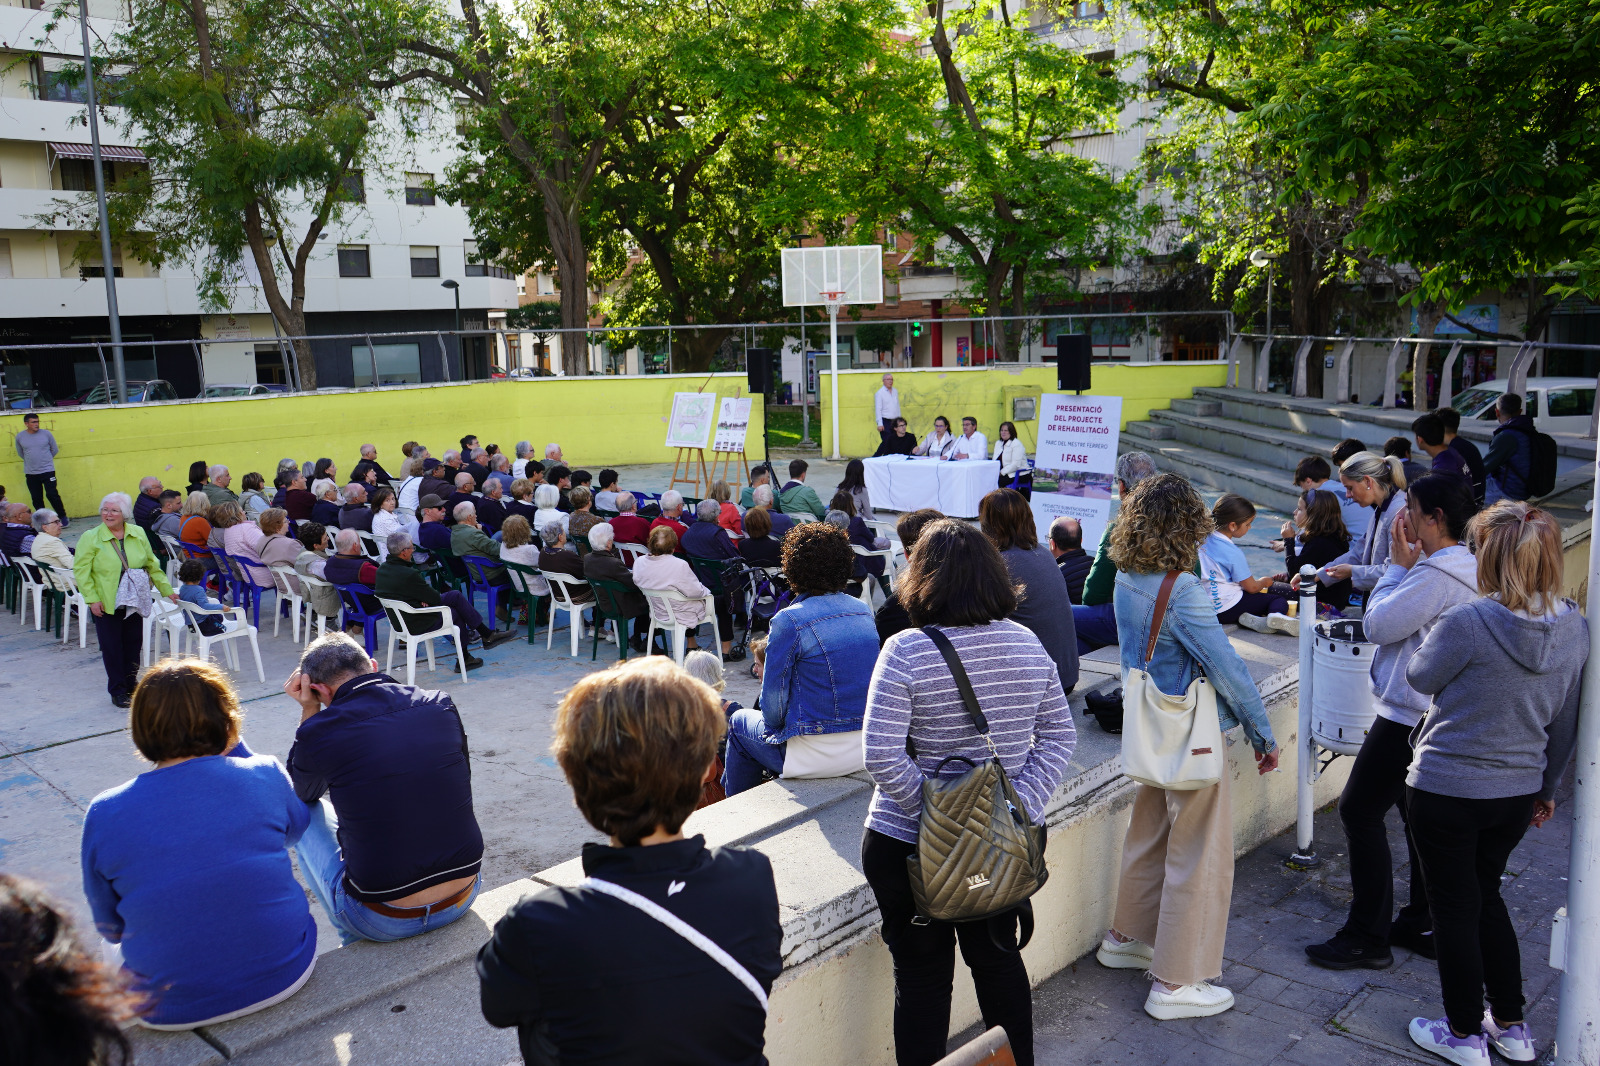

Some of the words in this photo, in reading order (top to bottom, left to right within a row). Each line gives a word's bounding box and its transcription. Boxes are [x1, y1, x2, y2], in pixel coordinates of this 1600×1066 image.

[1056, 405, 1102, 413] PRESENTACIÓ
[1057, 425, 1109, 434] REHABILITACIÓ
[1066, 454, 1088, 463] FASE
[966, 873, 988, 885] V&L
